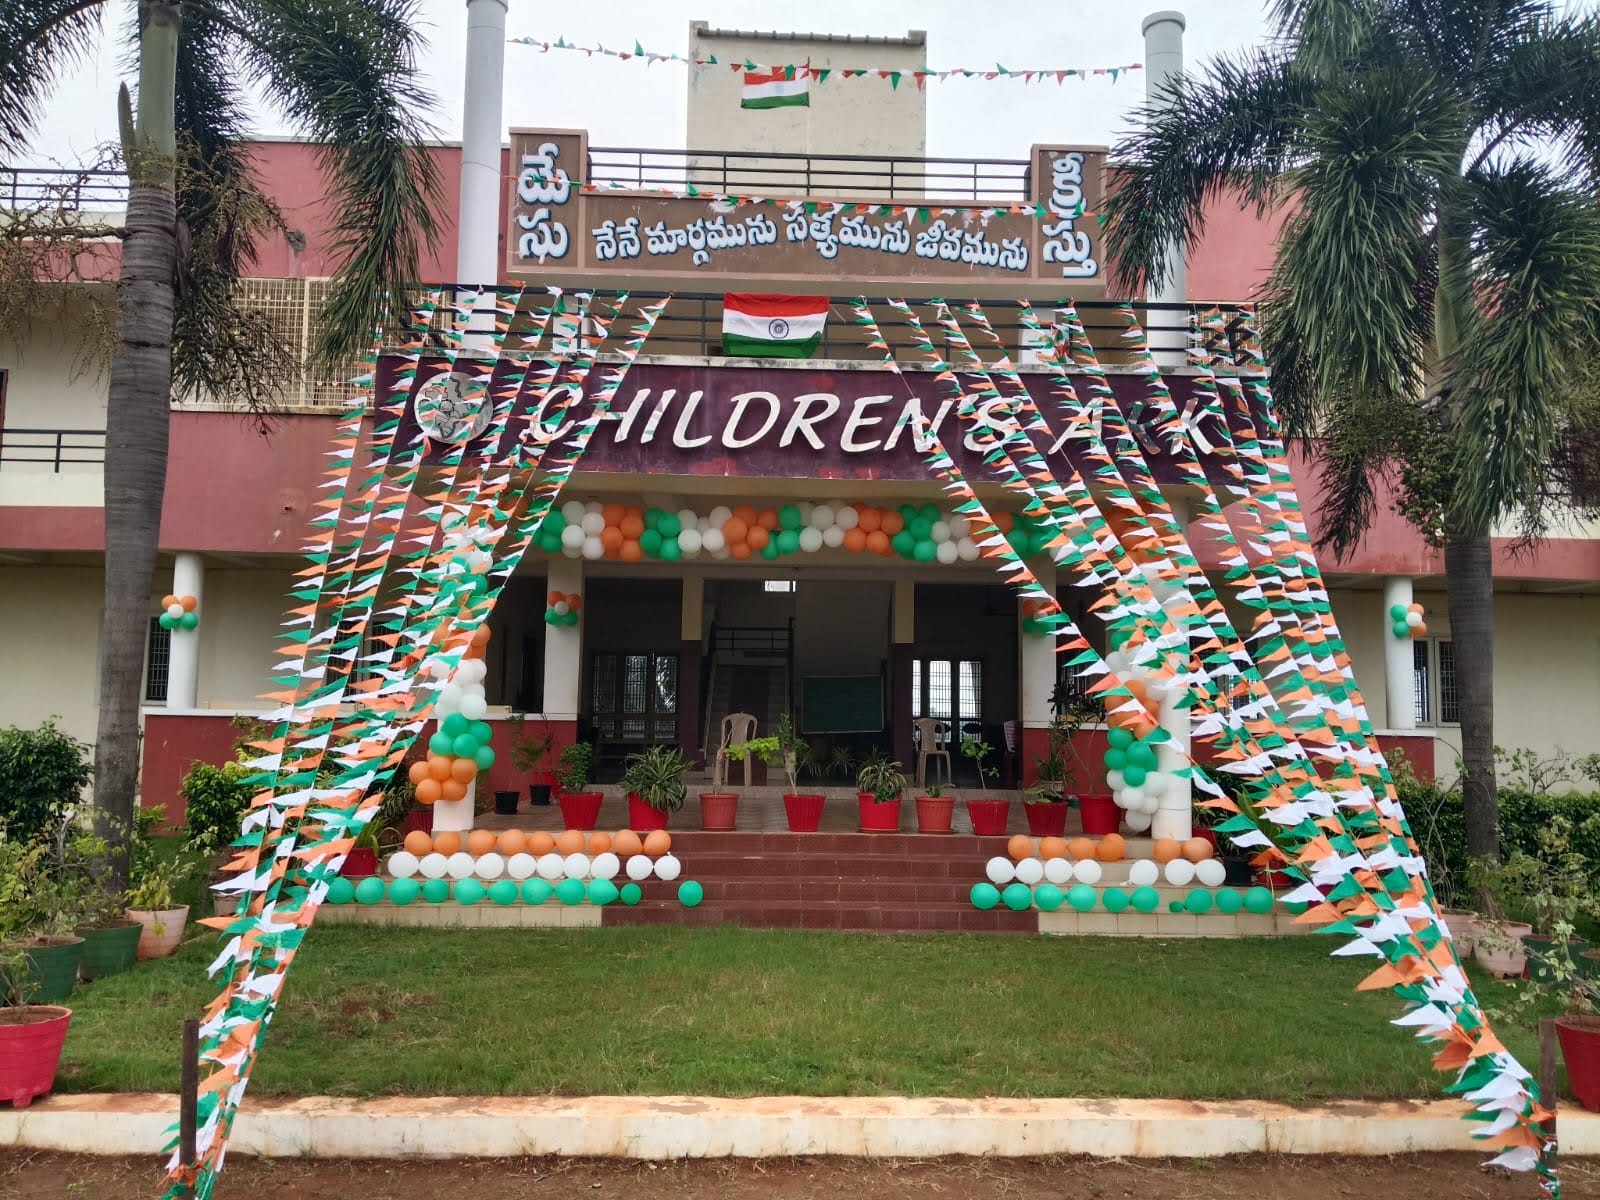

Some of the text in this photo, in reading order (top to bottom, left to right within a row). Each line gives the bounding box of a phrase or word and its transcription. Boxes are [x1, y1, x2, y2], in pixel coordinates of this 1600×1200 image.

[591, 207, 1029, 271] నేనే మార్గమును సత్యమును జీవమును
[1048, 397, 1219, 456] ARK
